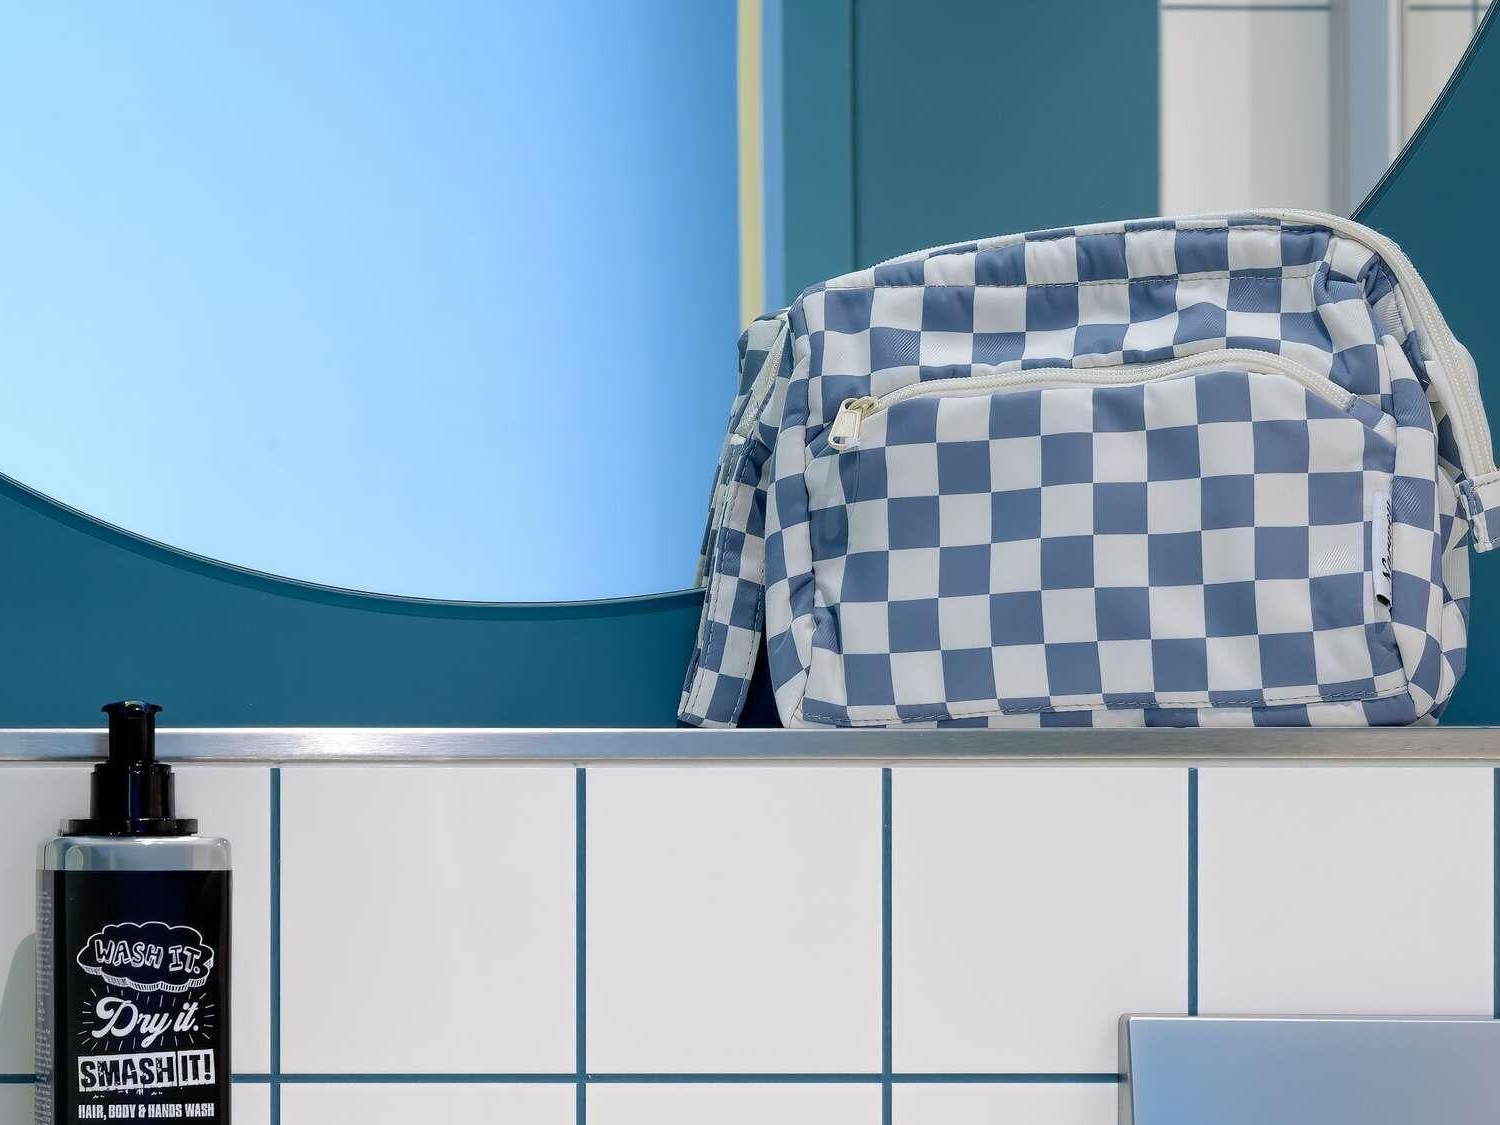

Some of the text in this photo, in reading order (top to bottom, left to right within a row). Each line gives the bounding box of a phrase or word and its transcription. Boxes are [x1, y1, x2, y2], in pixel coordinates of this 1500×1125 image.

[95, 939, 202, 974] WASH IT.
[91, 996, 200, 1048] Dry it.
[79, 1053, 213, 1088] SMASH IT!
[78, 1102, 215, 1121] HAIR, BODY & HANDS WASH
